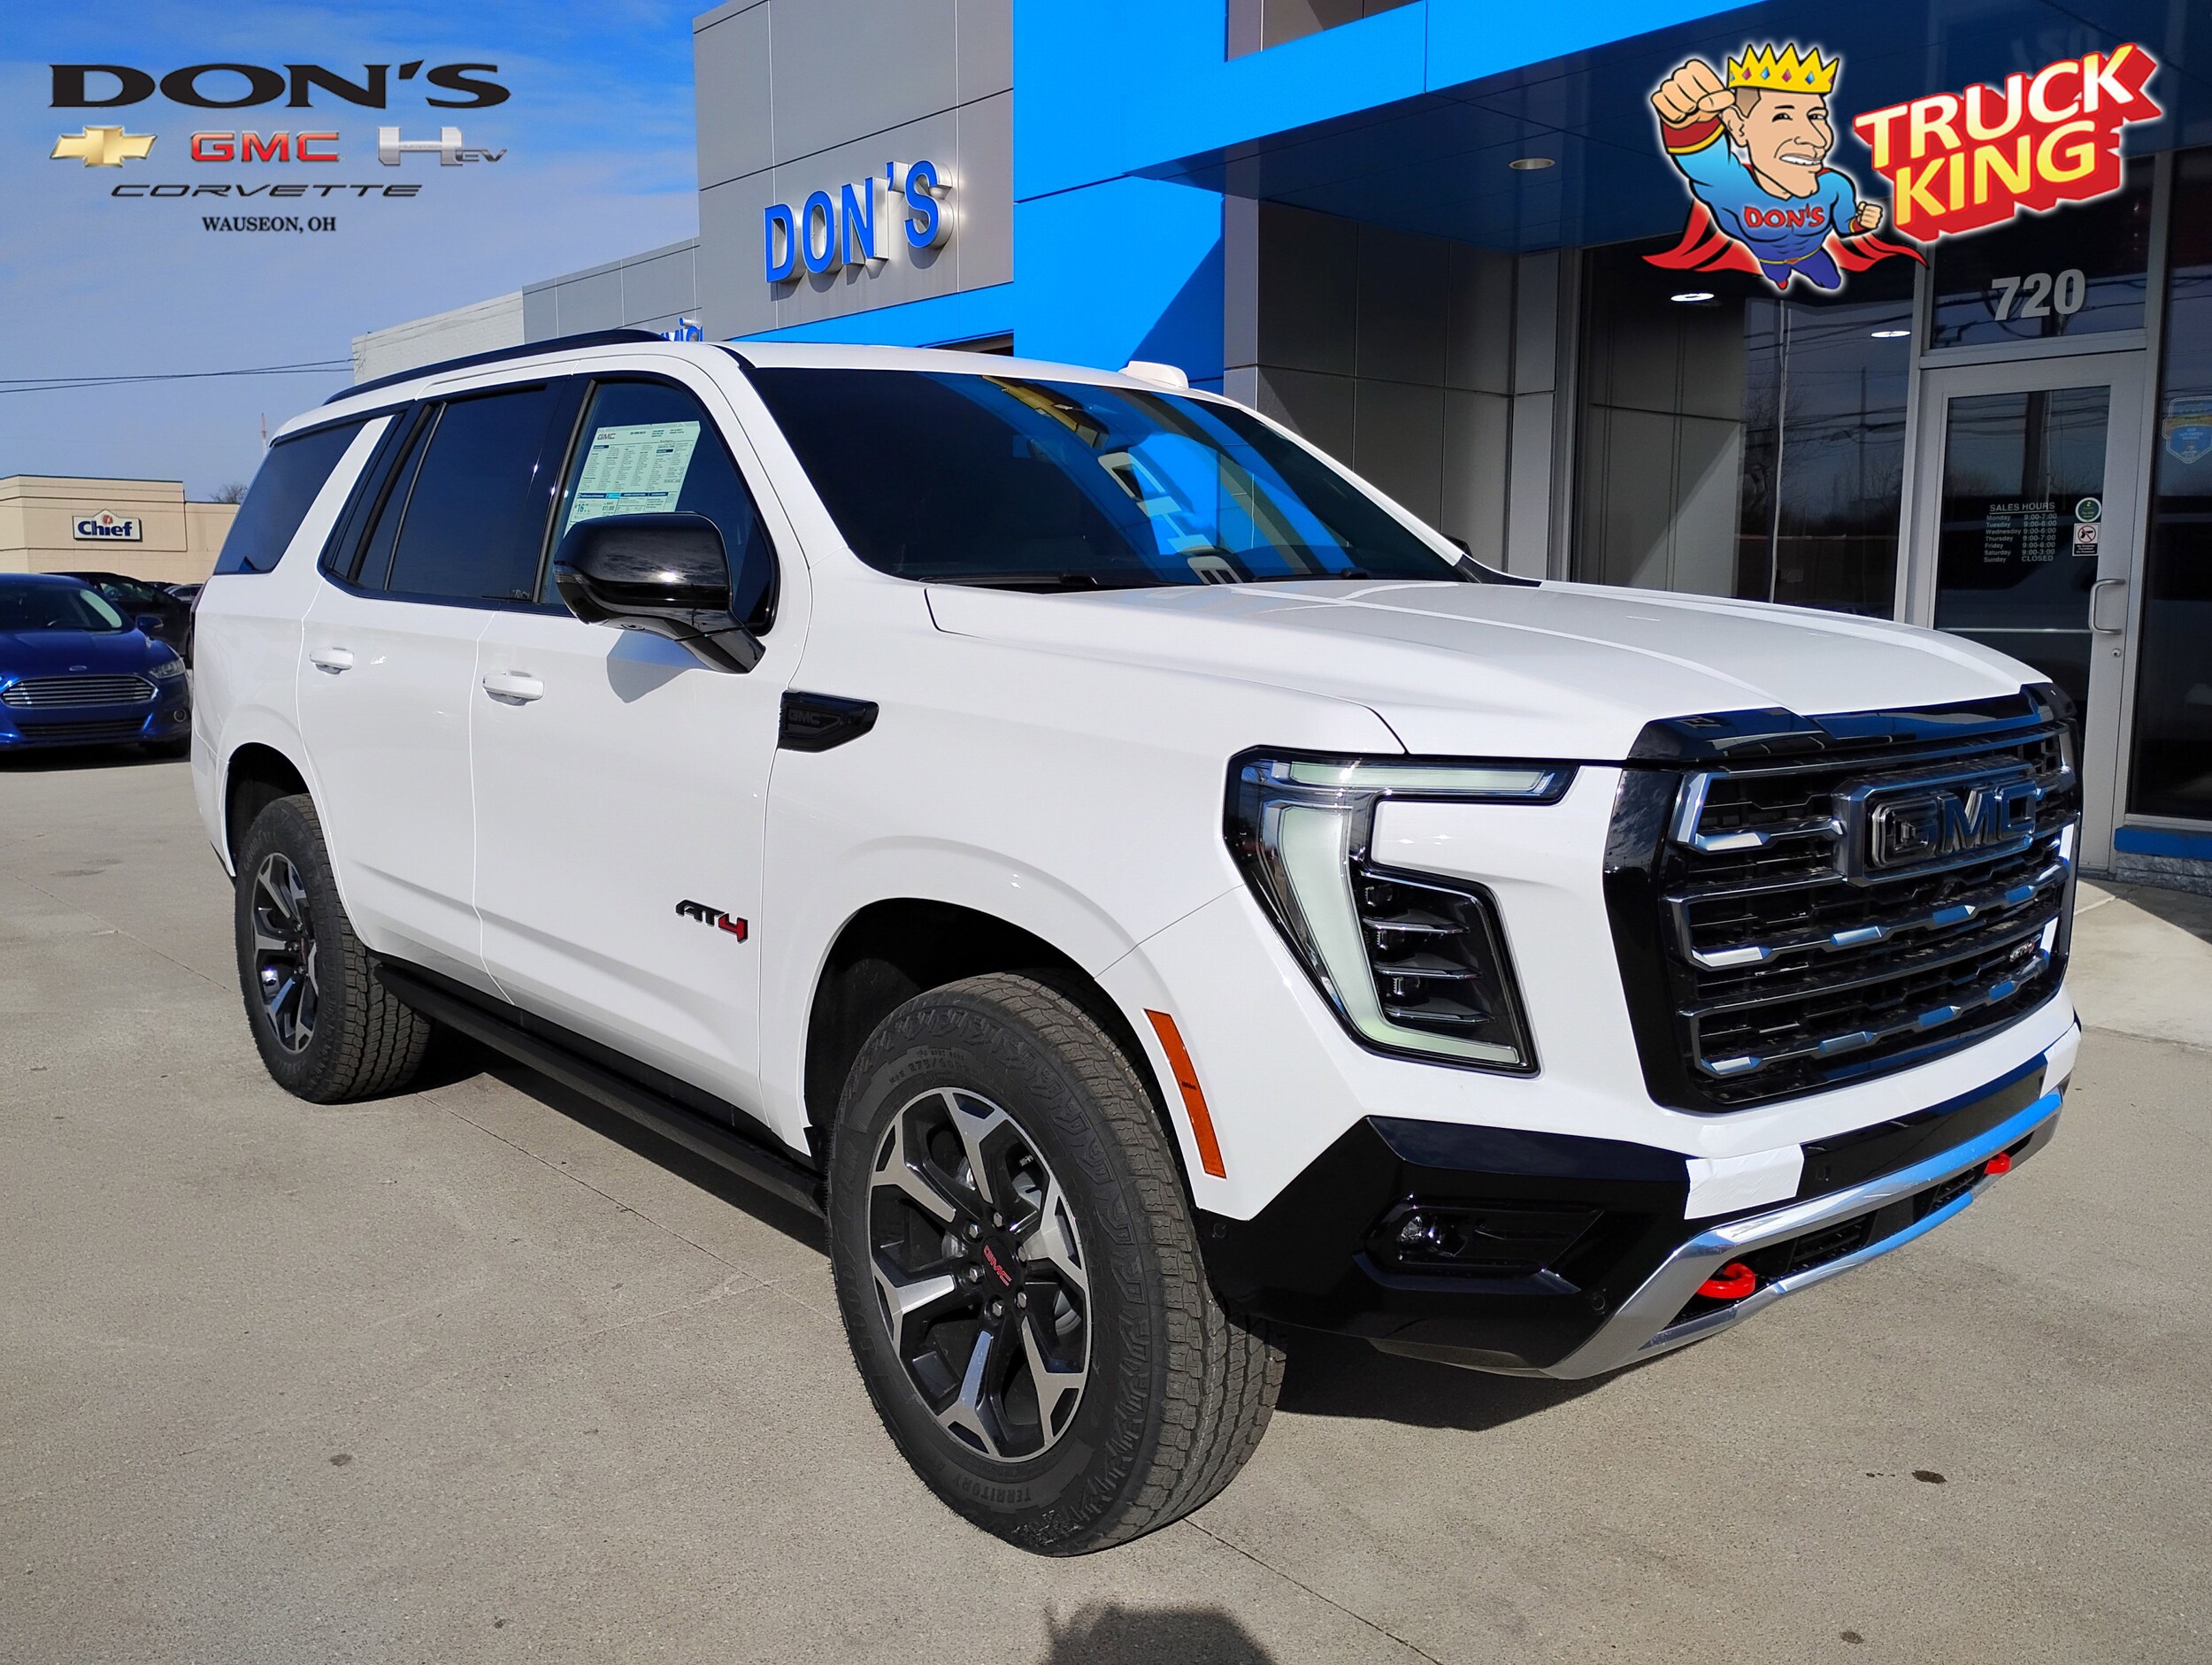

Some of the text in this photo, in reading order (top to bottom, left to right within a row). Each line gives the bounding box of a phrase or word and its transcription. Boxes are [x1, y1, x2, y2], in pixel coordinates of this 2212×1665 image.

[764, 159, 943, 283] DON'S
[1991, 268, 2085, 321] 720
[77, 520, 133, 536] Chief
[1989, 502, 2055, 512] SALES HOURS
[788, 709, 820, 725] GMC
[1871, 782, 2036, 867] GMC
[675, 899, 749, 943] AT4
[983, 1245, 1012, 1287] GMC
